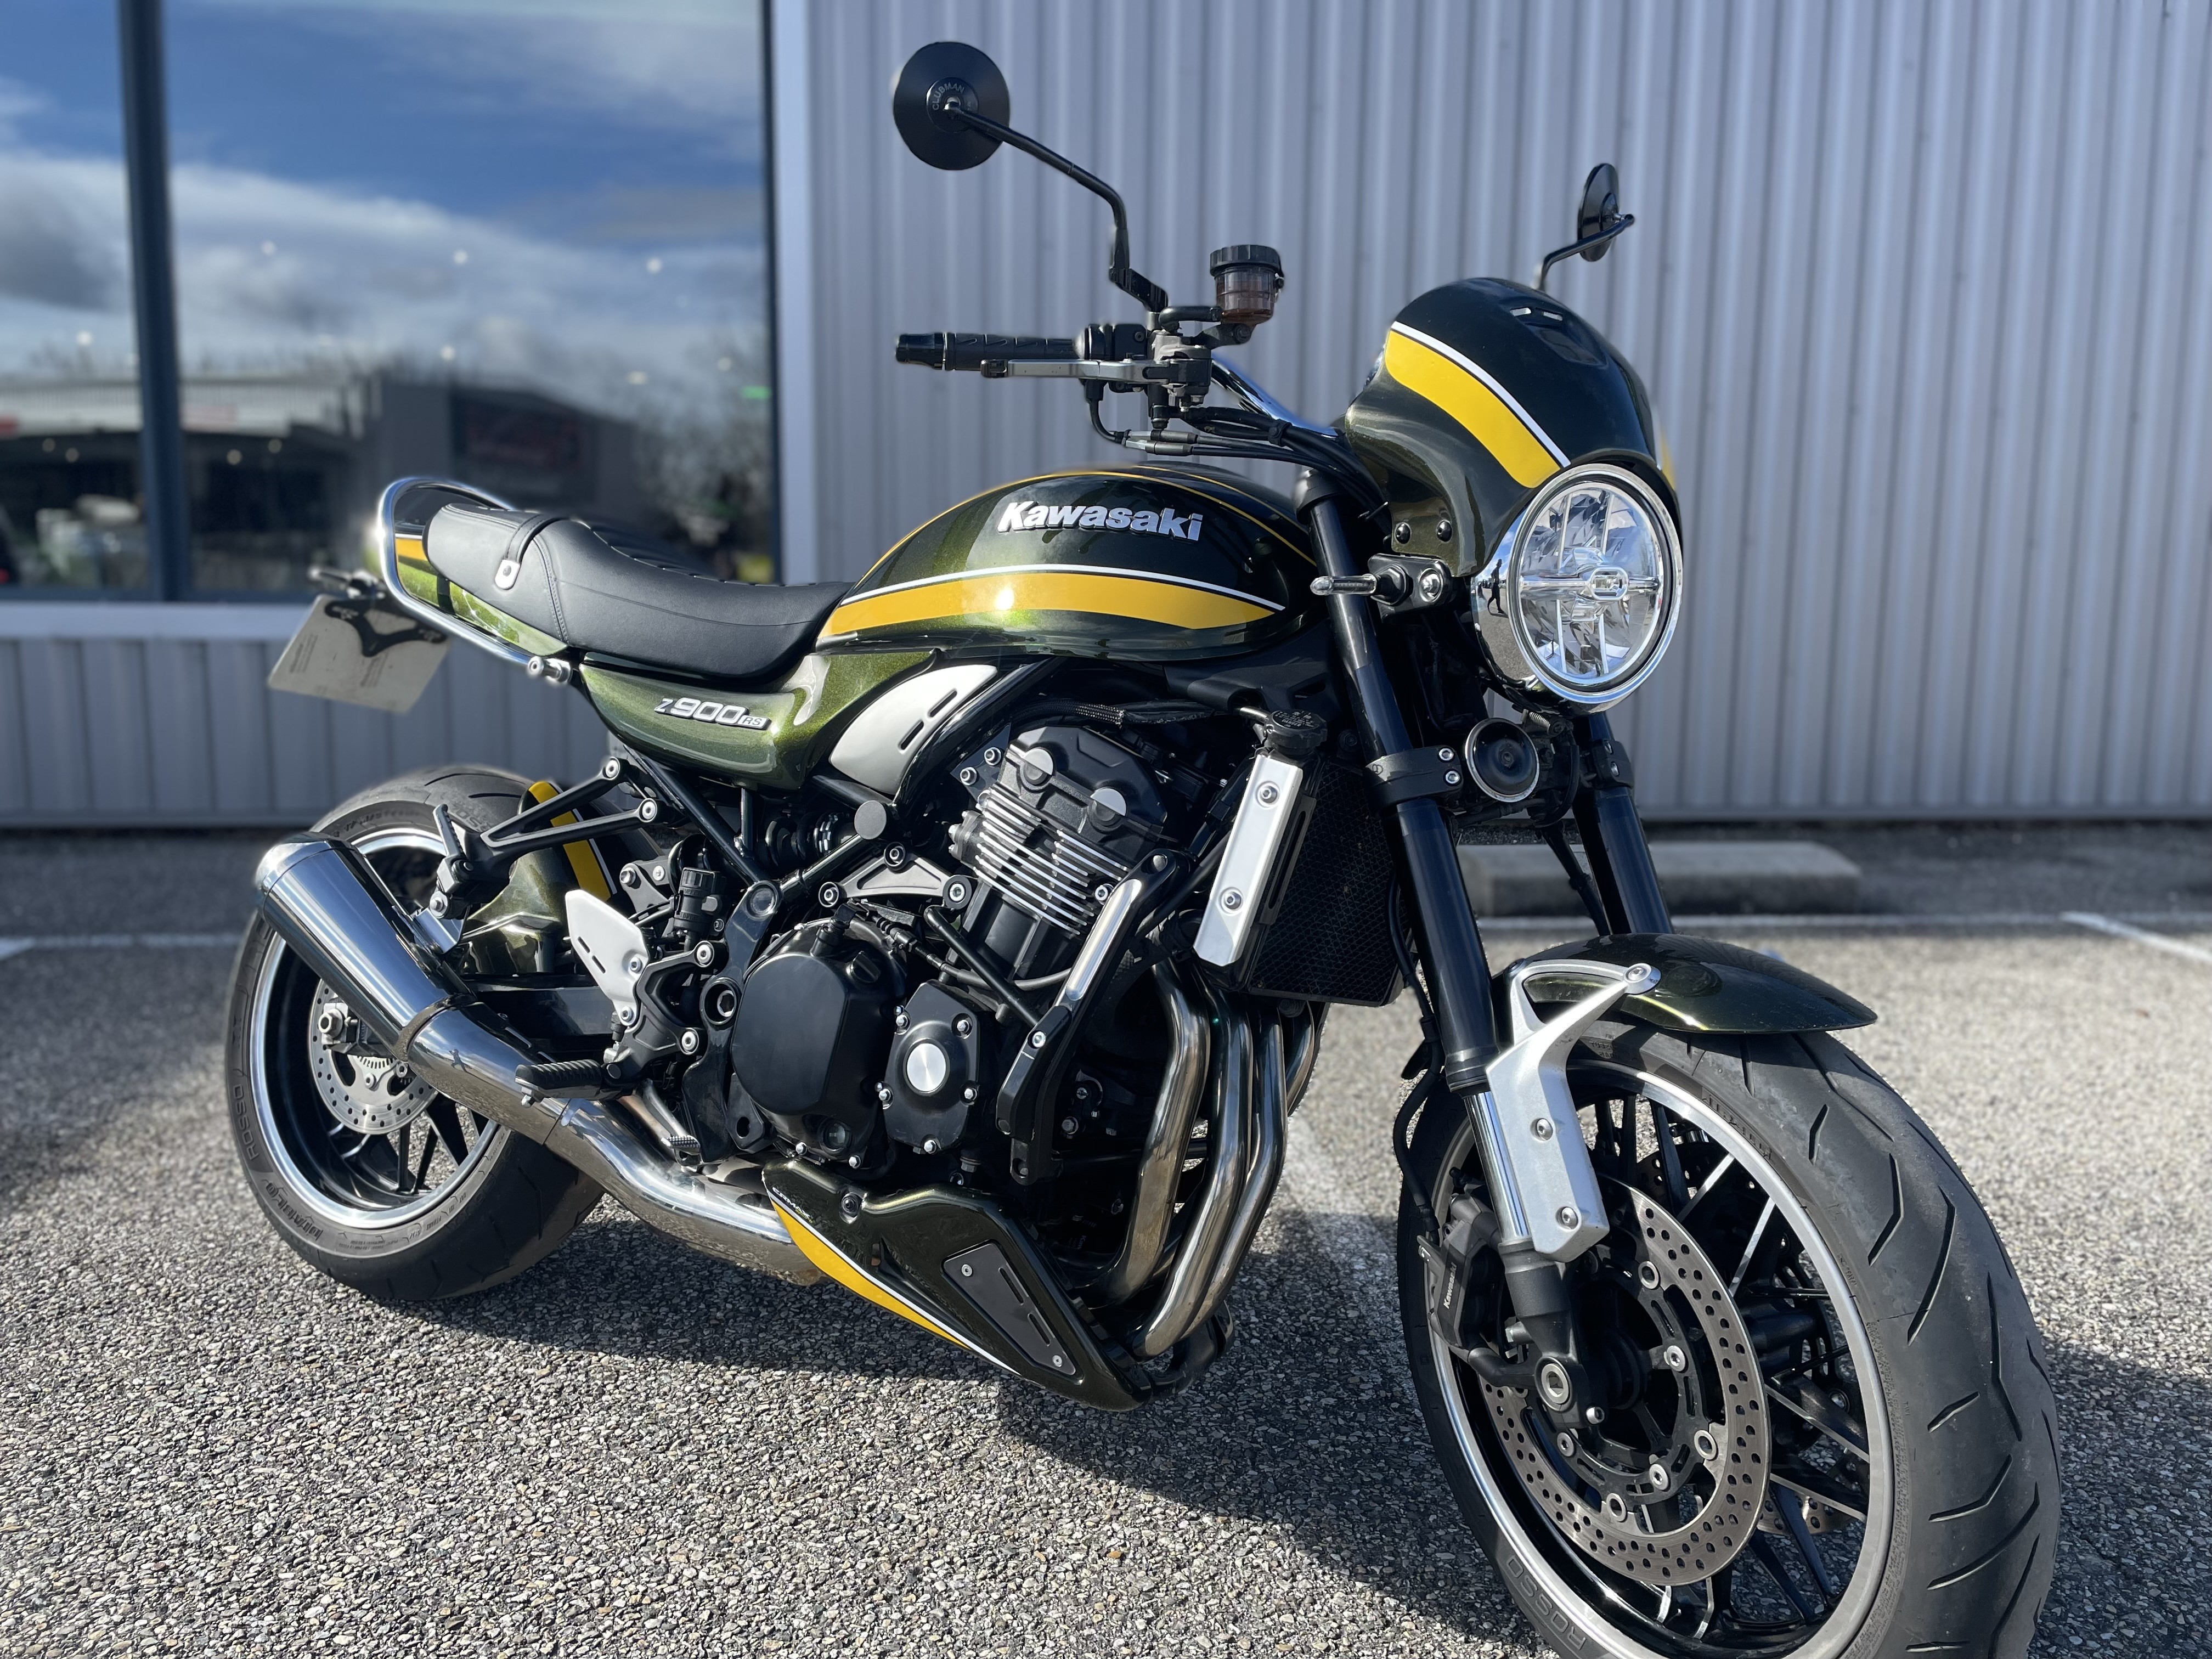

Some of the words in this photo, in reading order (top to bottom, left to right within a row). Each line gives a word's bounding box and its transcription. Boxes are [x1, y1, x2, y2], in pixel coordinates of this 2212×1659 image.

[997, 500, 1204, 541] Kawasaki
[233, 1084, 260, 1160] ROSSO
[266, 1183, 324, 1241] DIABLO
[1443, 1262, 1457, 1309] Kawasaki
[1506, 1555, 1587, 1651] ROSSO
